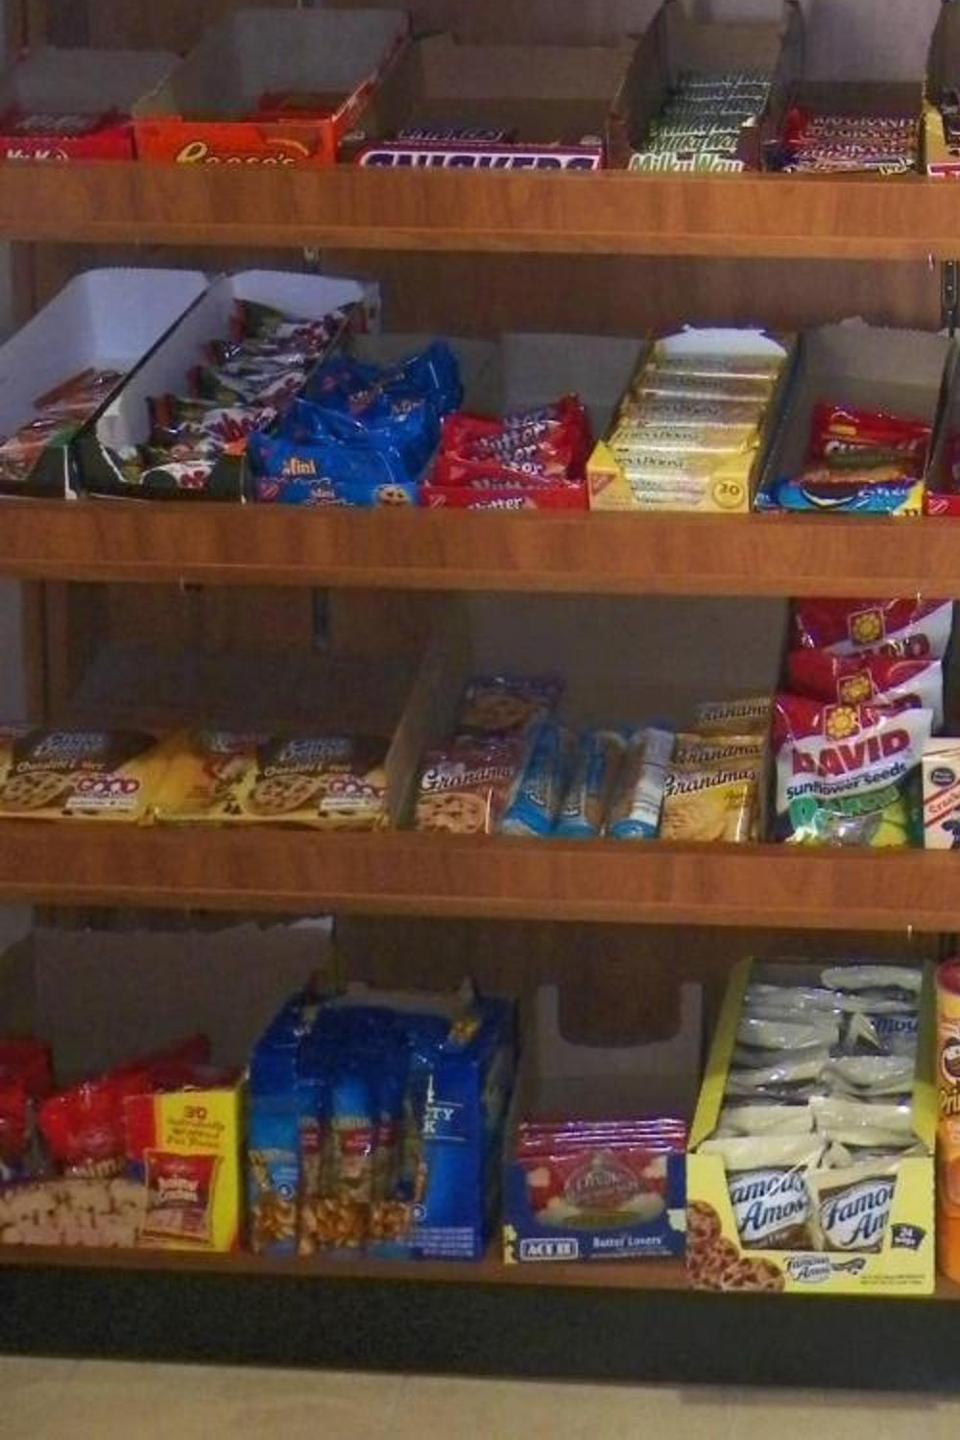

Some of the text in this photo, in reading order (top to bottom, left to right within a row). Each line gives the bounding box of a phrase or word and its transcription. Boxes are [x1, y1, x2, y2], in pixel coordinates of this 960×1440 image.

[792, 728, 911, 777] DAVID
[863, 761, 907, 785] seeds
[786, 779, 861, 800] sunflower
[731, 1173, 805, 1205] amous
[824, 1183, 895, 1231] Famo
